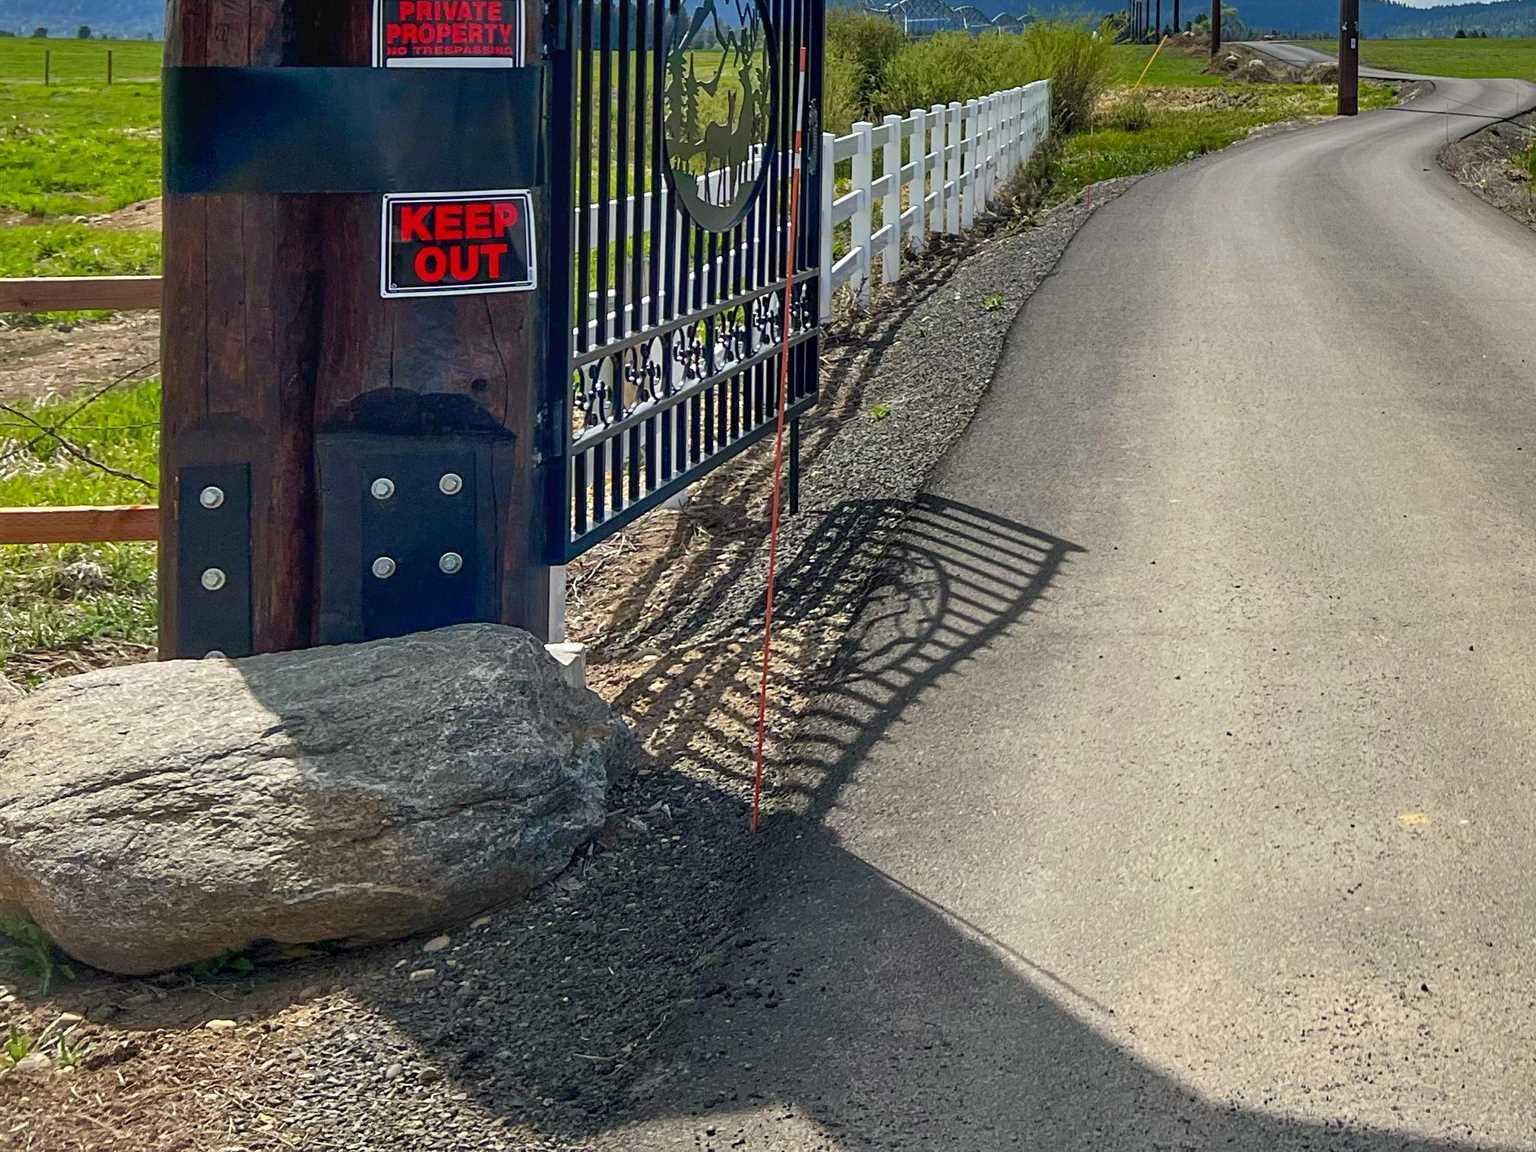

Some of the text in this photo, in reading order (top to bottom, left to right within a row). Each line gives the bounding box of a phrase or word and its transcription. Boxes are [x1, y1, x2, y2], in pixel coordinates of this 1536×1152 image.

[399, 0, 502, 21] PRIVATE
[387, 23, 512, 44] PROPERTY
[387, 46, 512, 56] NO TRESPASSING
[400, 203, 518, 242] KEEP
[414, 243, 508, 283] OUT
